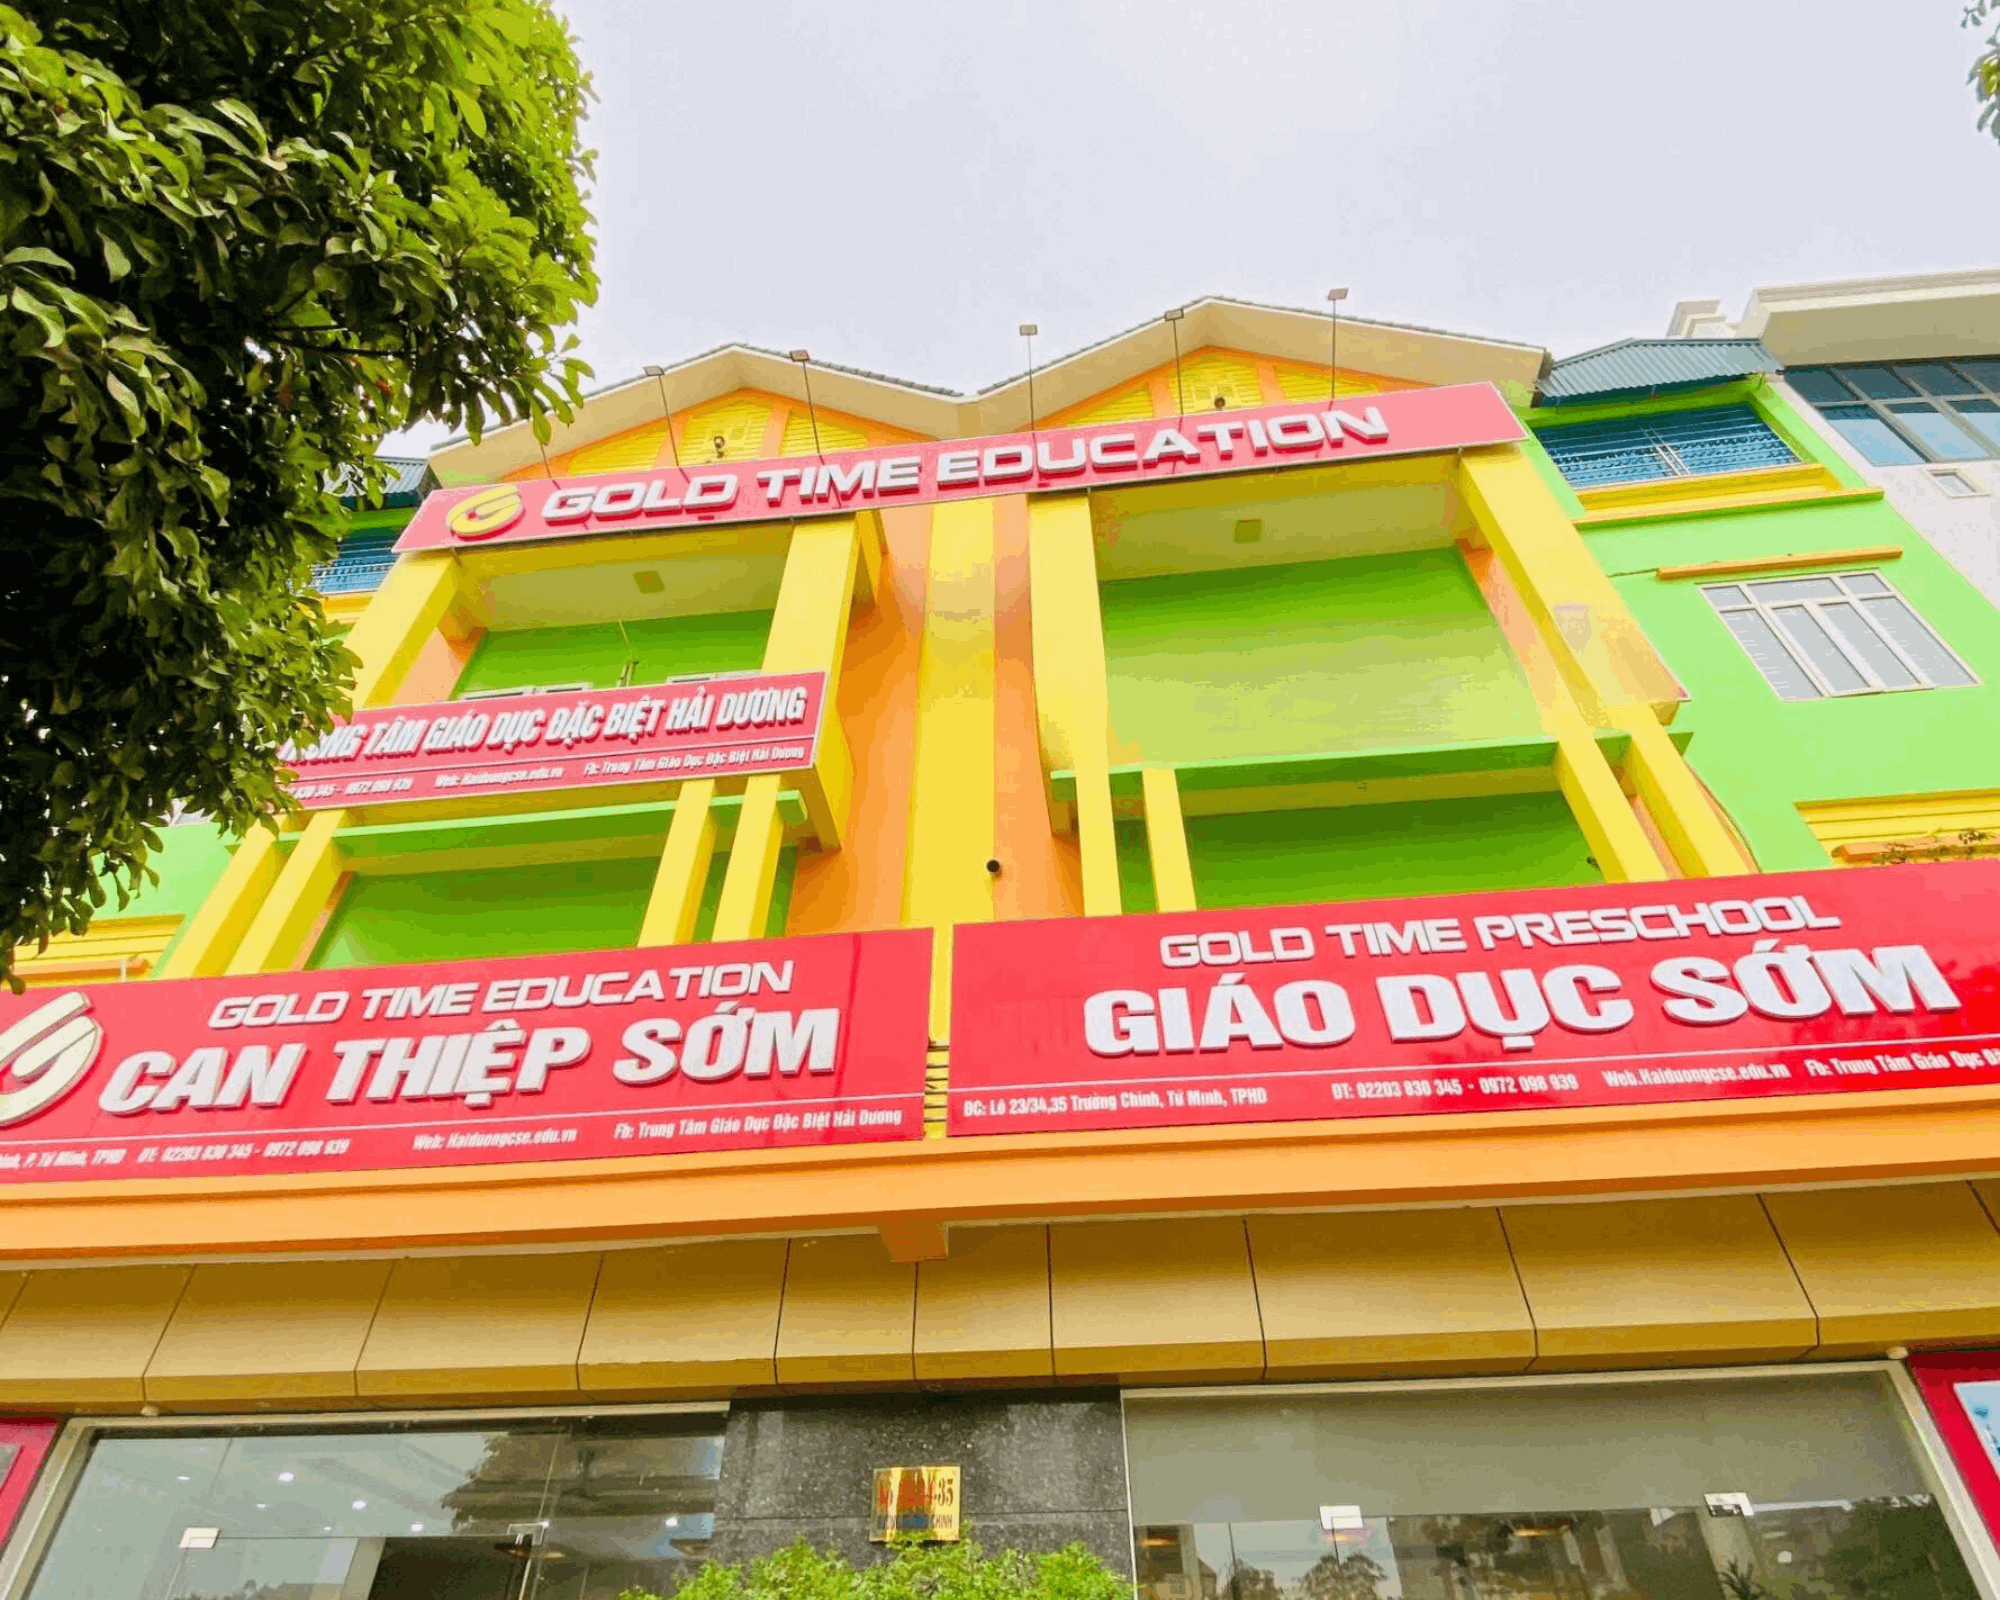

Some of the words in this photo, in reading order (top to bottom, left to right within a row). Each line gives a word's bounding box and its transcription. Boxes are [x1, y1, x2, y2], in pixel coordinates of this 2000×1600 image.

[541, 473, 739, 520] GOLD
[757, 455, 922, 502] TIME
[936, 406, 1389, 486] EDUCATION
[362, 715, 430, 756] TÂM
[423, 709, 492, 751] GIÁO
[486, 709, 547, 753] DỤC
[545, 700, 604, 744] ĐẶC
[603, 695, 666, 740] BIỆT
[665, 685, 716, 731] HẢI
[715, 686, 808, 726] DƯƠNG
[1159, 926, 1316, 969] GOLD
[1325, 917, 1467, 958] TIME
[1473, 894, 1843, 950] PRESCHOOL
[207, 990, 352, 1031] GOLD
[360, 982, 480, 1021] TIME
[481, 959, 795, 1014] EDUCATION
[1083, 971, 1357, 1058] GIÁO
[1374, 963, 1635, 1053] DỤC
[1650, 938, 1964, 1027] SỚM
[98, 1042, 308, 1116] CAN
[325, 1017, 592, 1109] THIỆP
[612, 1000, 842, 1086] SỚM
[1229, 1086, 1268, 1106] TPHD
[1356, 1080, 1402, 1099] 02203
[1433, 1078, 1464, 1096] 345
[1478, 1076, 1518, 1095] 0972
[1803, 1058, 1835, 1078] Fb:
[1828, 1057, 1880, 1076] Trung
[1873, 1053, 1915, 1073] Tâm
[1910, 1050, 1951, 1071] Giáo
[1949, 1049, 1985, 1071] Dục
[613, 1122, 634, 1139] Fb:
[638, 1121, 676, 1140] Trung
[678, 1118, 707, 1136] Tâm
[710, 1115, 740, 1134] Giáo
[743, 1114, 770, 1136] Dục
[802, 1110, 830, 1132] Biệt
